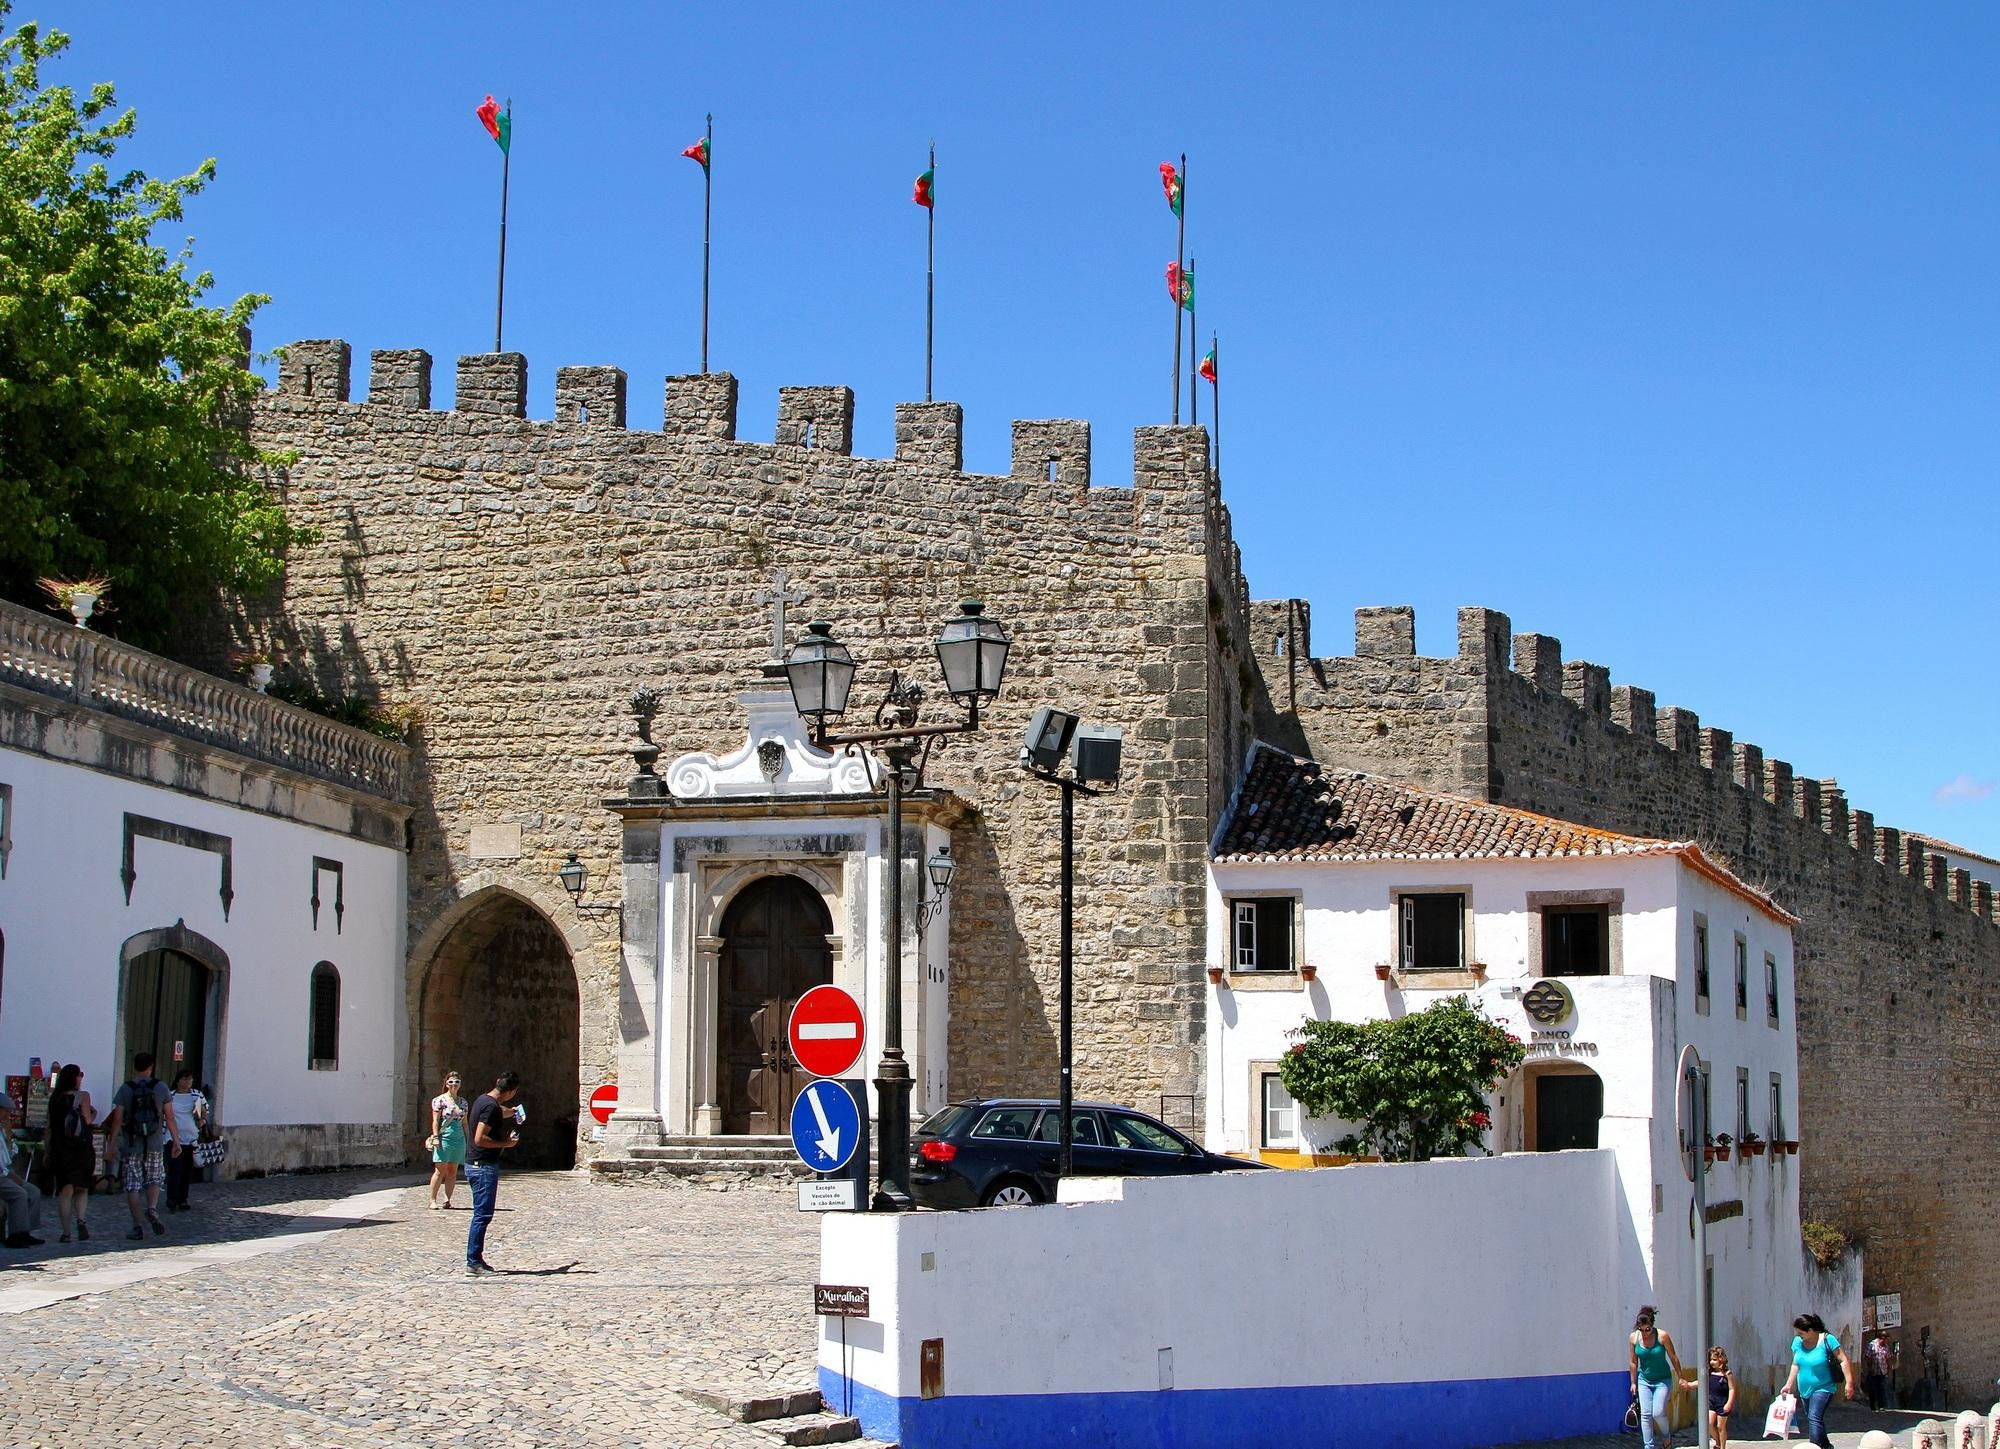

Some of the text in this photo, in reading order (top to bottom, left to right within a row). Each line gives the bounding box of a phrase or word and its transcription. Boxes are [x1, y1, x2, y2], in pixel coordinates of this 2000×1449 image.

[1531, 1031, 1570, 1040] BANCO
[1558, 1042, 1597, 1051] SANTO
[818, 1290, 865, 1304] Muralhas
[1877, 1311, 1900, 1323] CONVENTO
